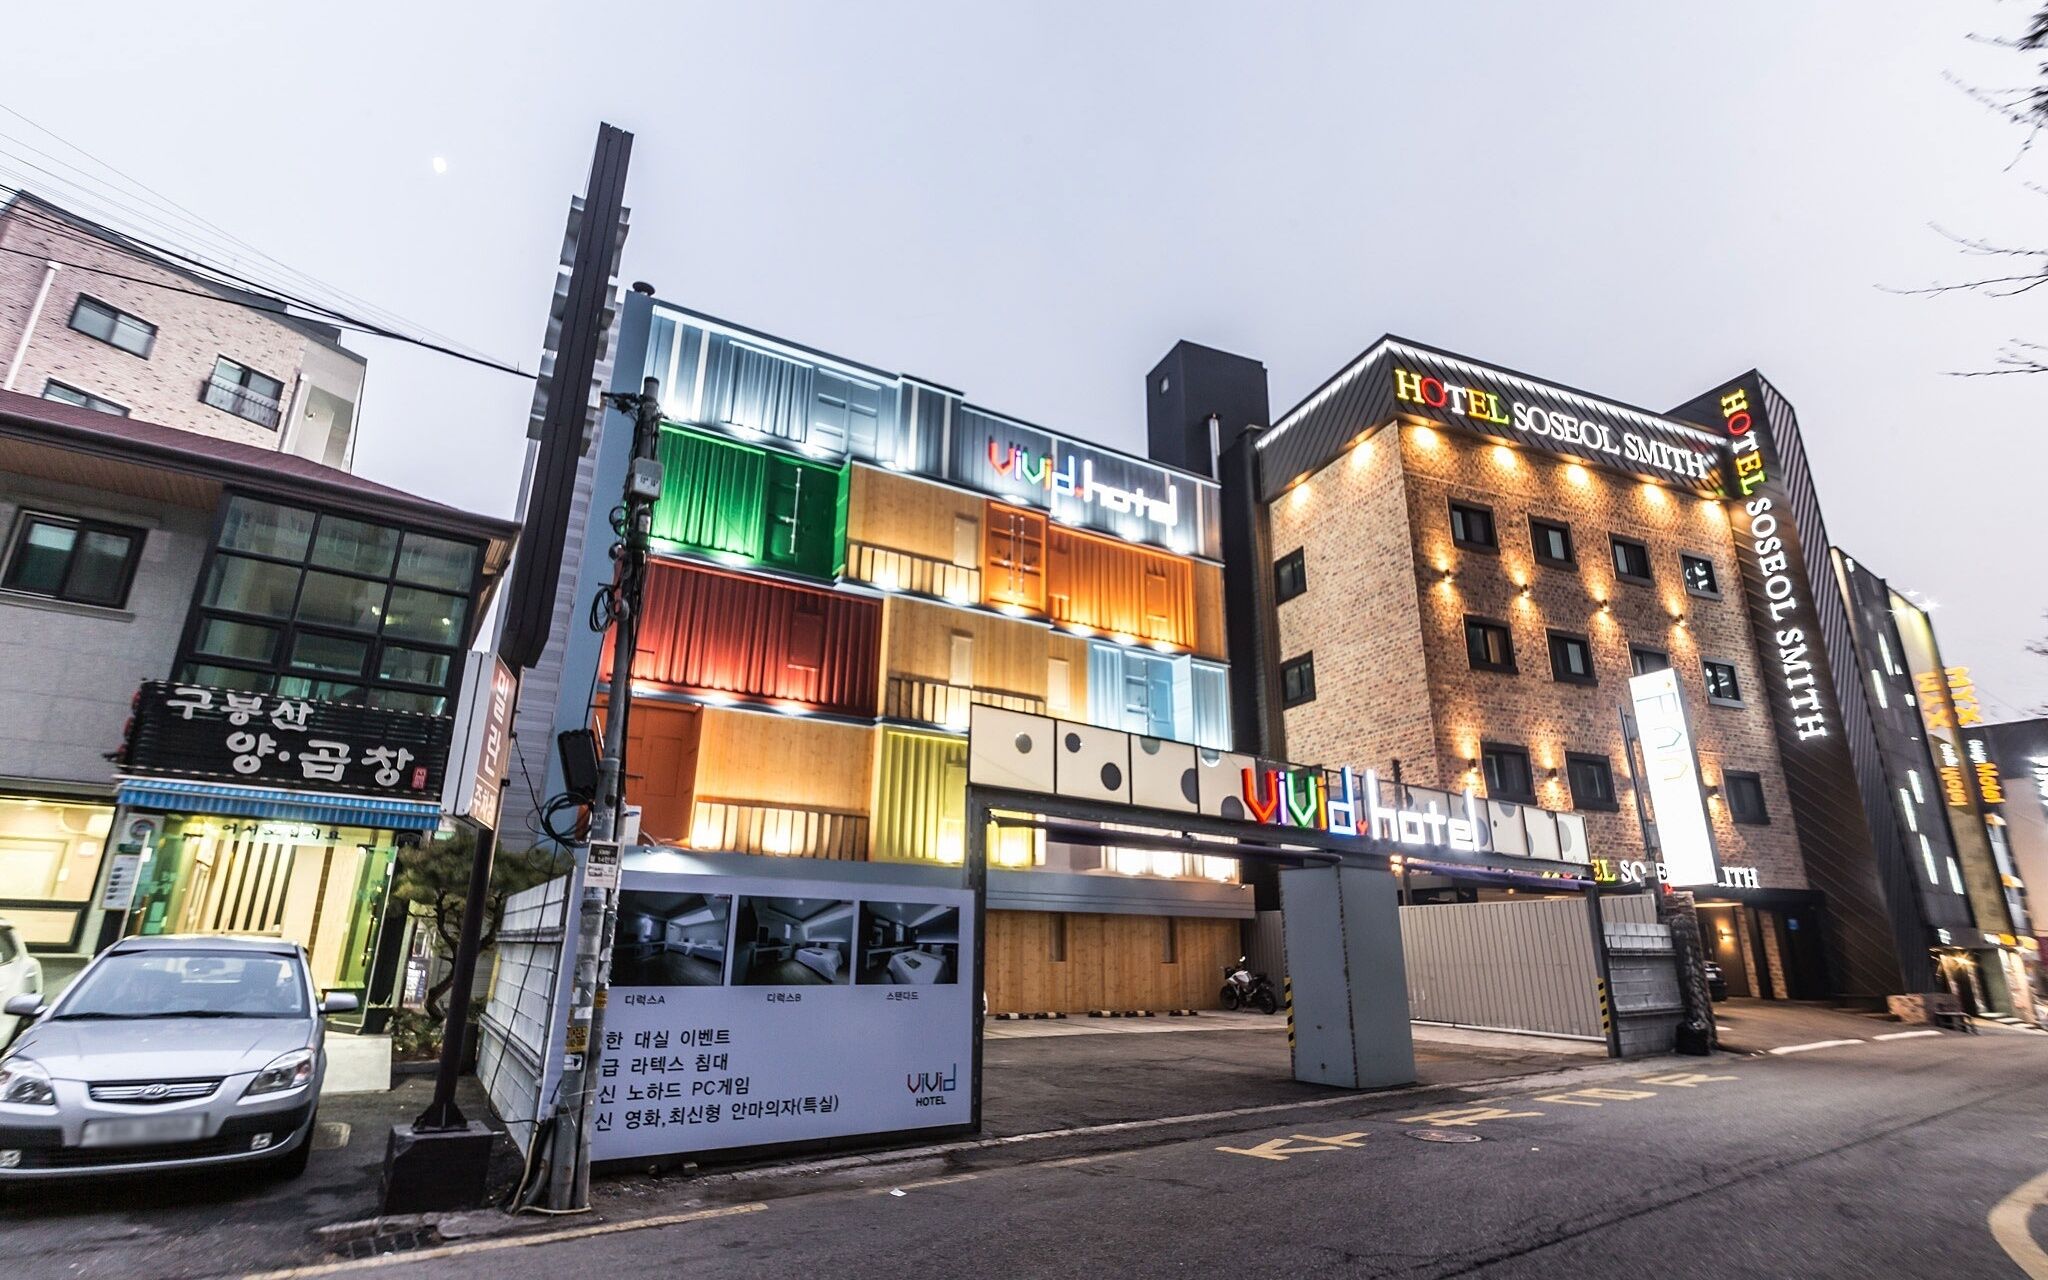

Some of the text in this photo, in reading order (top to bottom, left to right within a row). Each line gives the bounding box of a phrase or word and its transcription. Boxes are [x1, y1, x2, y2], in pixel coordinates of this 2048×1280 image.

[1394, 368, 1710, 480] HOTEL SOSEOL SMITH
[1720, 387, 1828, 741] HOTEL SOSEOL SMITH
[166, 686, 314, 732] 구봉산
[1362, 768, 1480, 852] hotel
[624, 993, 666, 1006] 디럭스A
[767, 991, 803, 1004] 디럭스B
[634, 1029, 670, 1049] 대실
[680, 1028, 731, 1047] 이벤트
[630, 1056, 684, 1075] 라텍스
[695, 1053, 729, 1073] 침대
[626, 1081, 682, 1101] 노하드
[692, 1076, 751, 1096] PC게임
[915, 1095, 947, 1107] HOTEL
[731, 1094, 840, 1121] 안마의자(특실)
